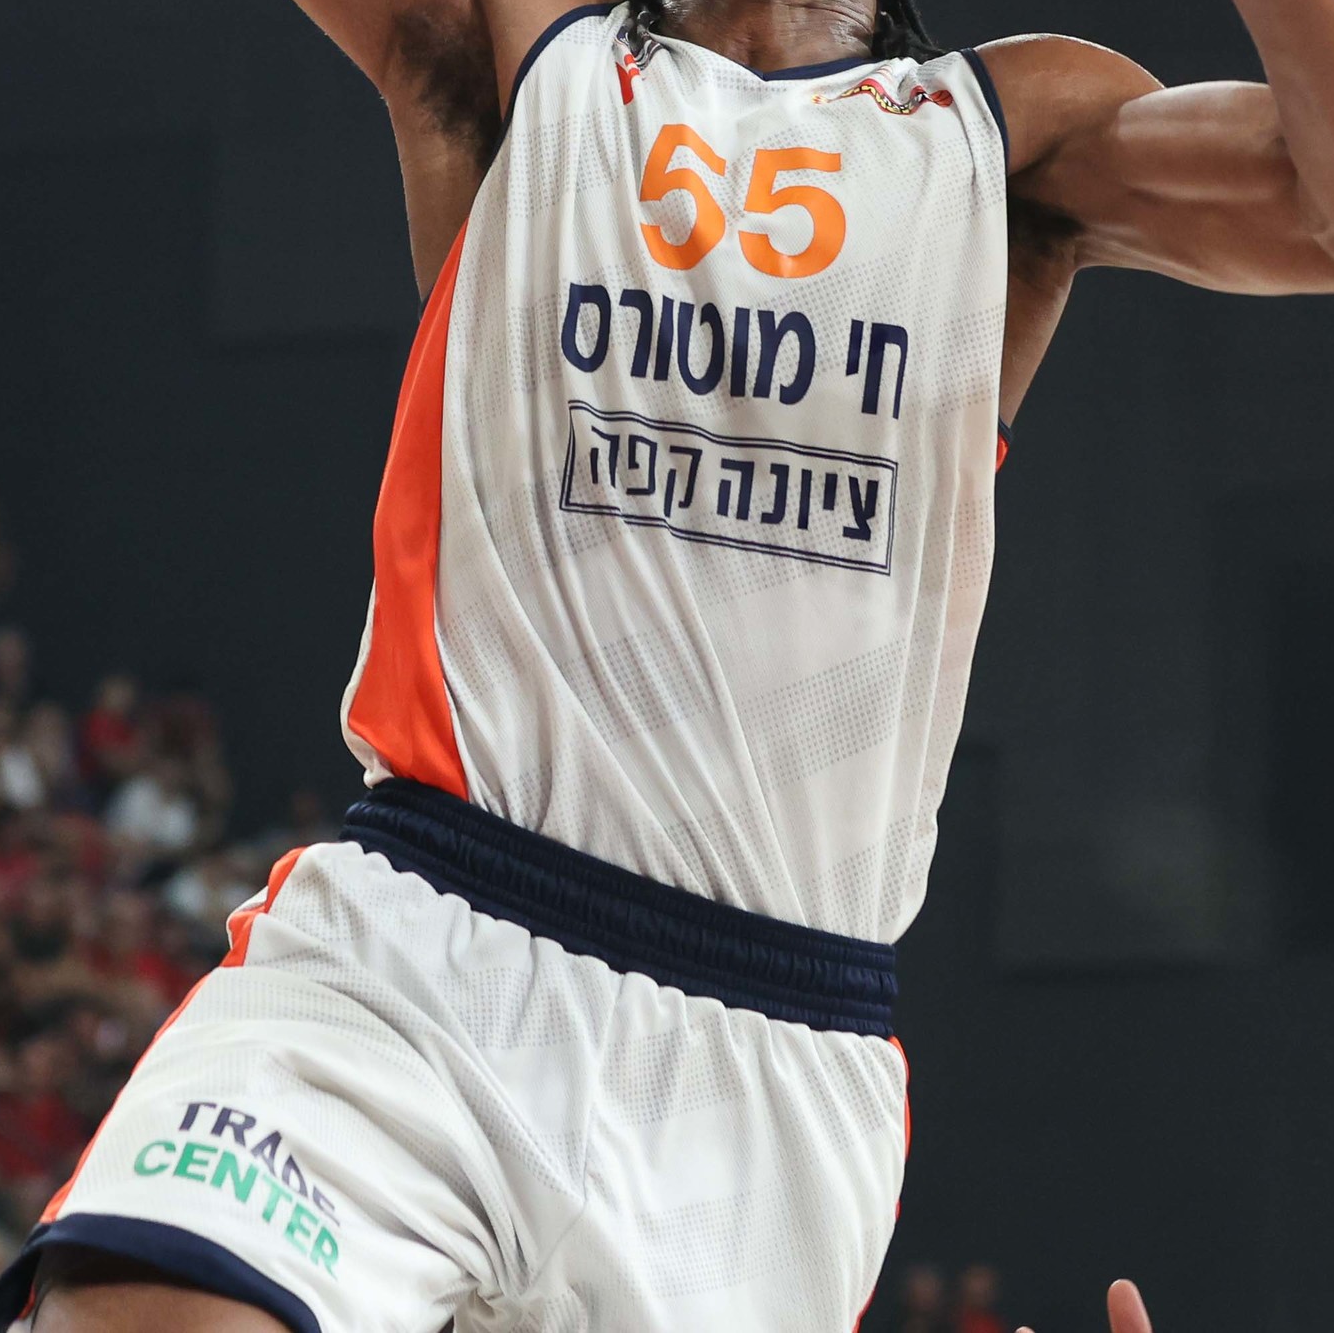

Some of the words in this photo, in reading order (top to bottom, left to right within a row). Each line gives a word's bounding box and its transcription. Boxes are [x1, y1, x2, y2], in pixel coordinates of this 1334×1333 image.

[639, 123, 846, 279] 55
[561, 282, 817, 406] מוטורס
[845, 319, 909, 420] חי
[589, 425, 703, 518] קפה
[716, 457, 879, 542] ציונה
[132, 1140, 341, 1281] CENTER
[178, 1101, 341, 1227] TRADE
